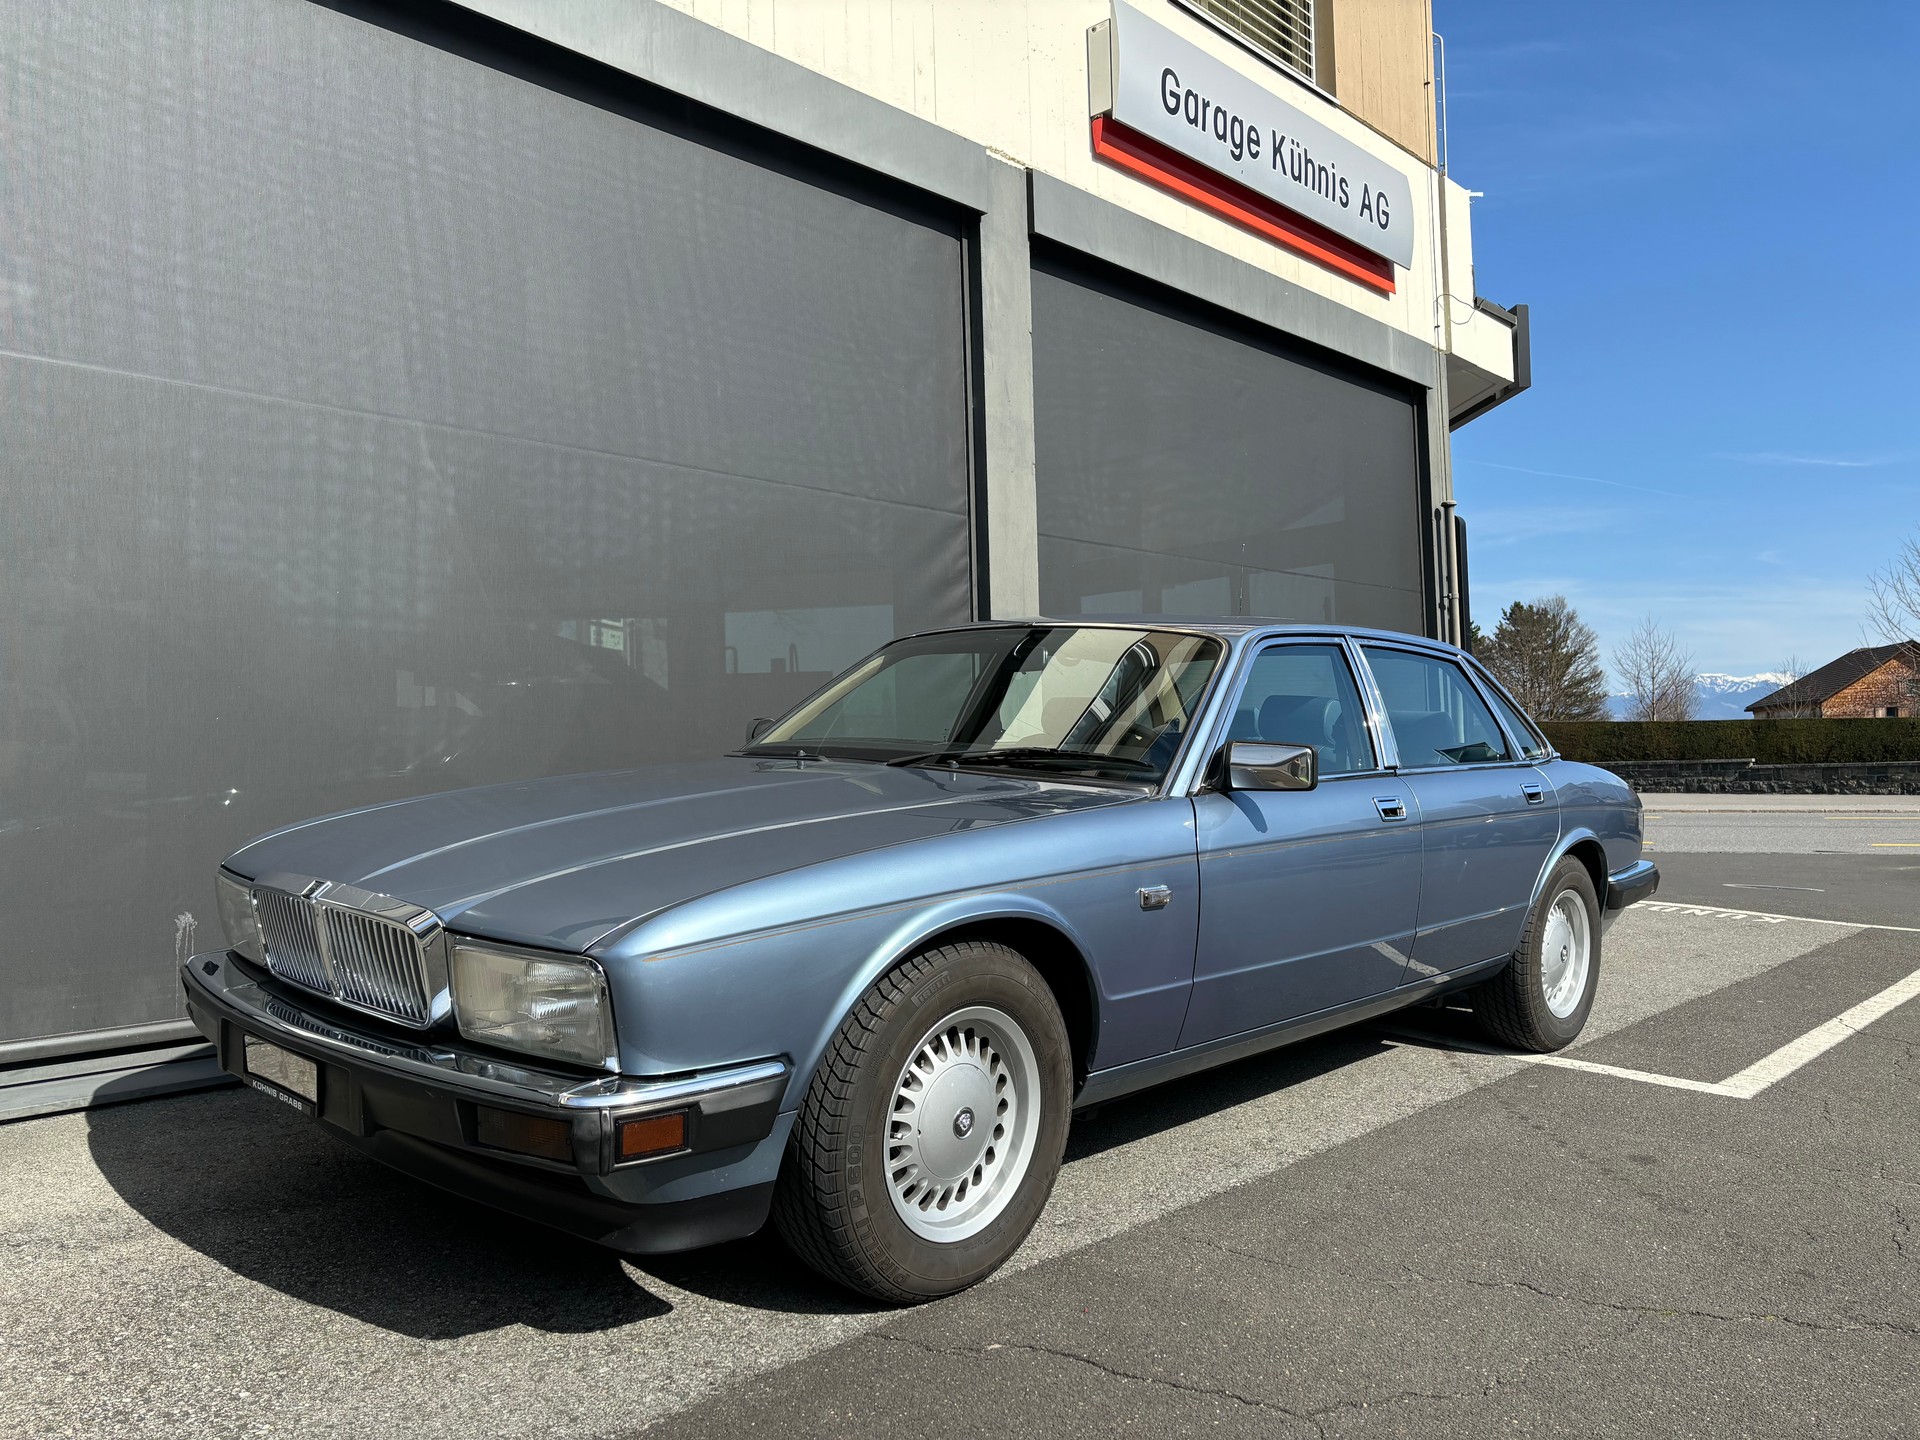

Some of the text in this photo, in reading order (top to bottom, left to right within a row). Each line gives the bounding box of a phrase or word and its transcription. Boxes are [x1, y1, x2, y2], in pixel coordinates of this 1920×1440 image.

[1161, 67, 1391, 230] Garage Kühnis AG
[278, 1092, 303, 1111] GRABS
[855, 1217, 911, 1287] PIRELLI
